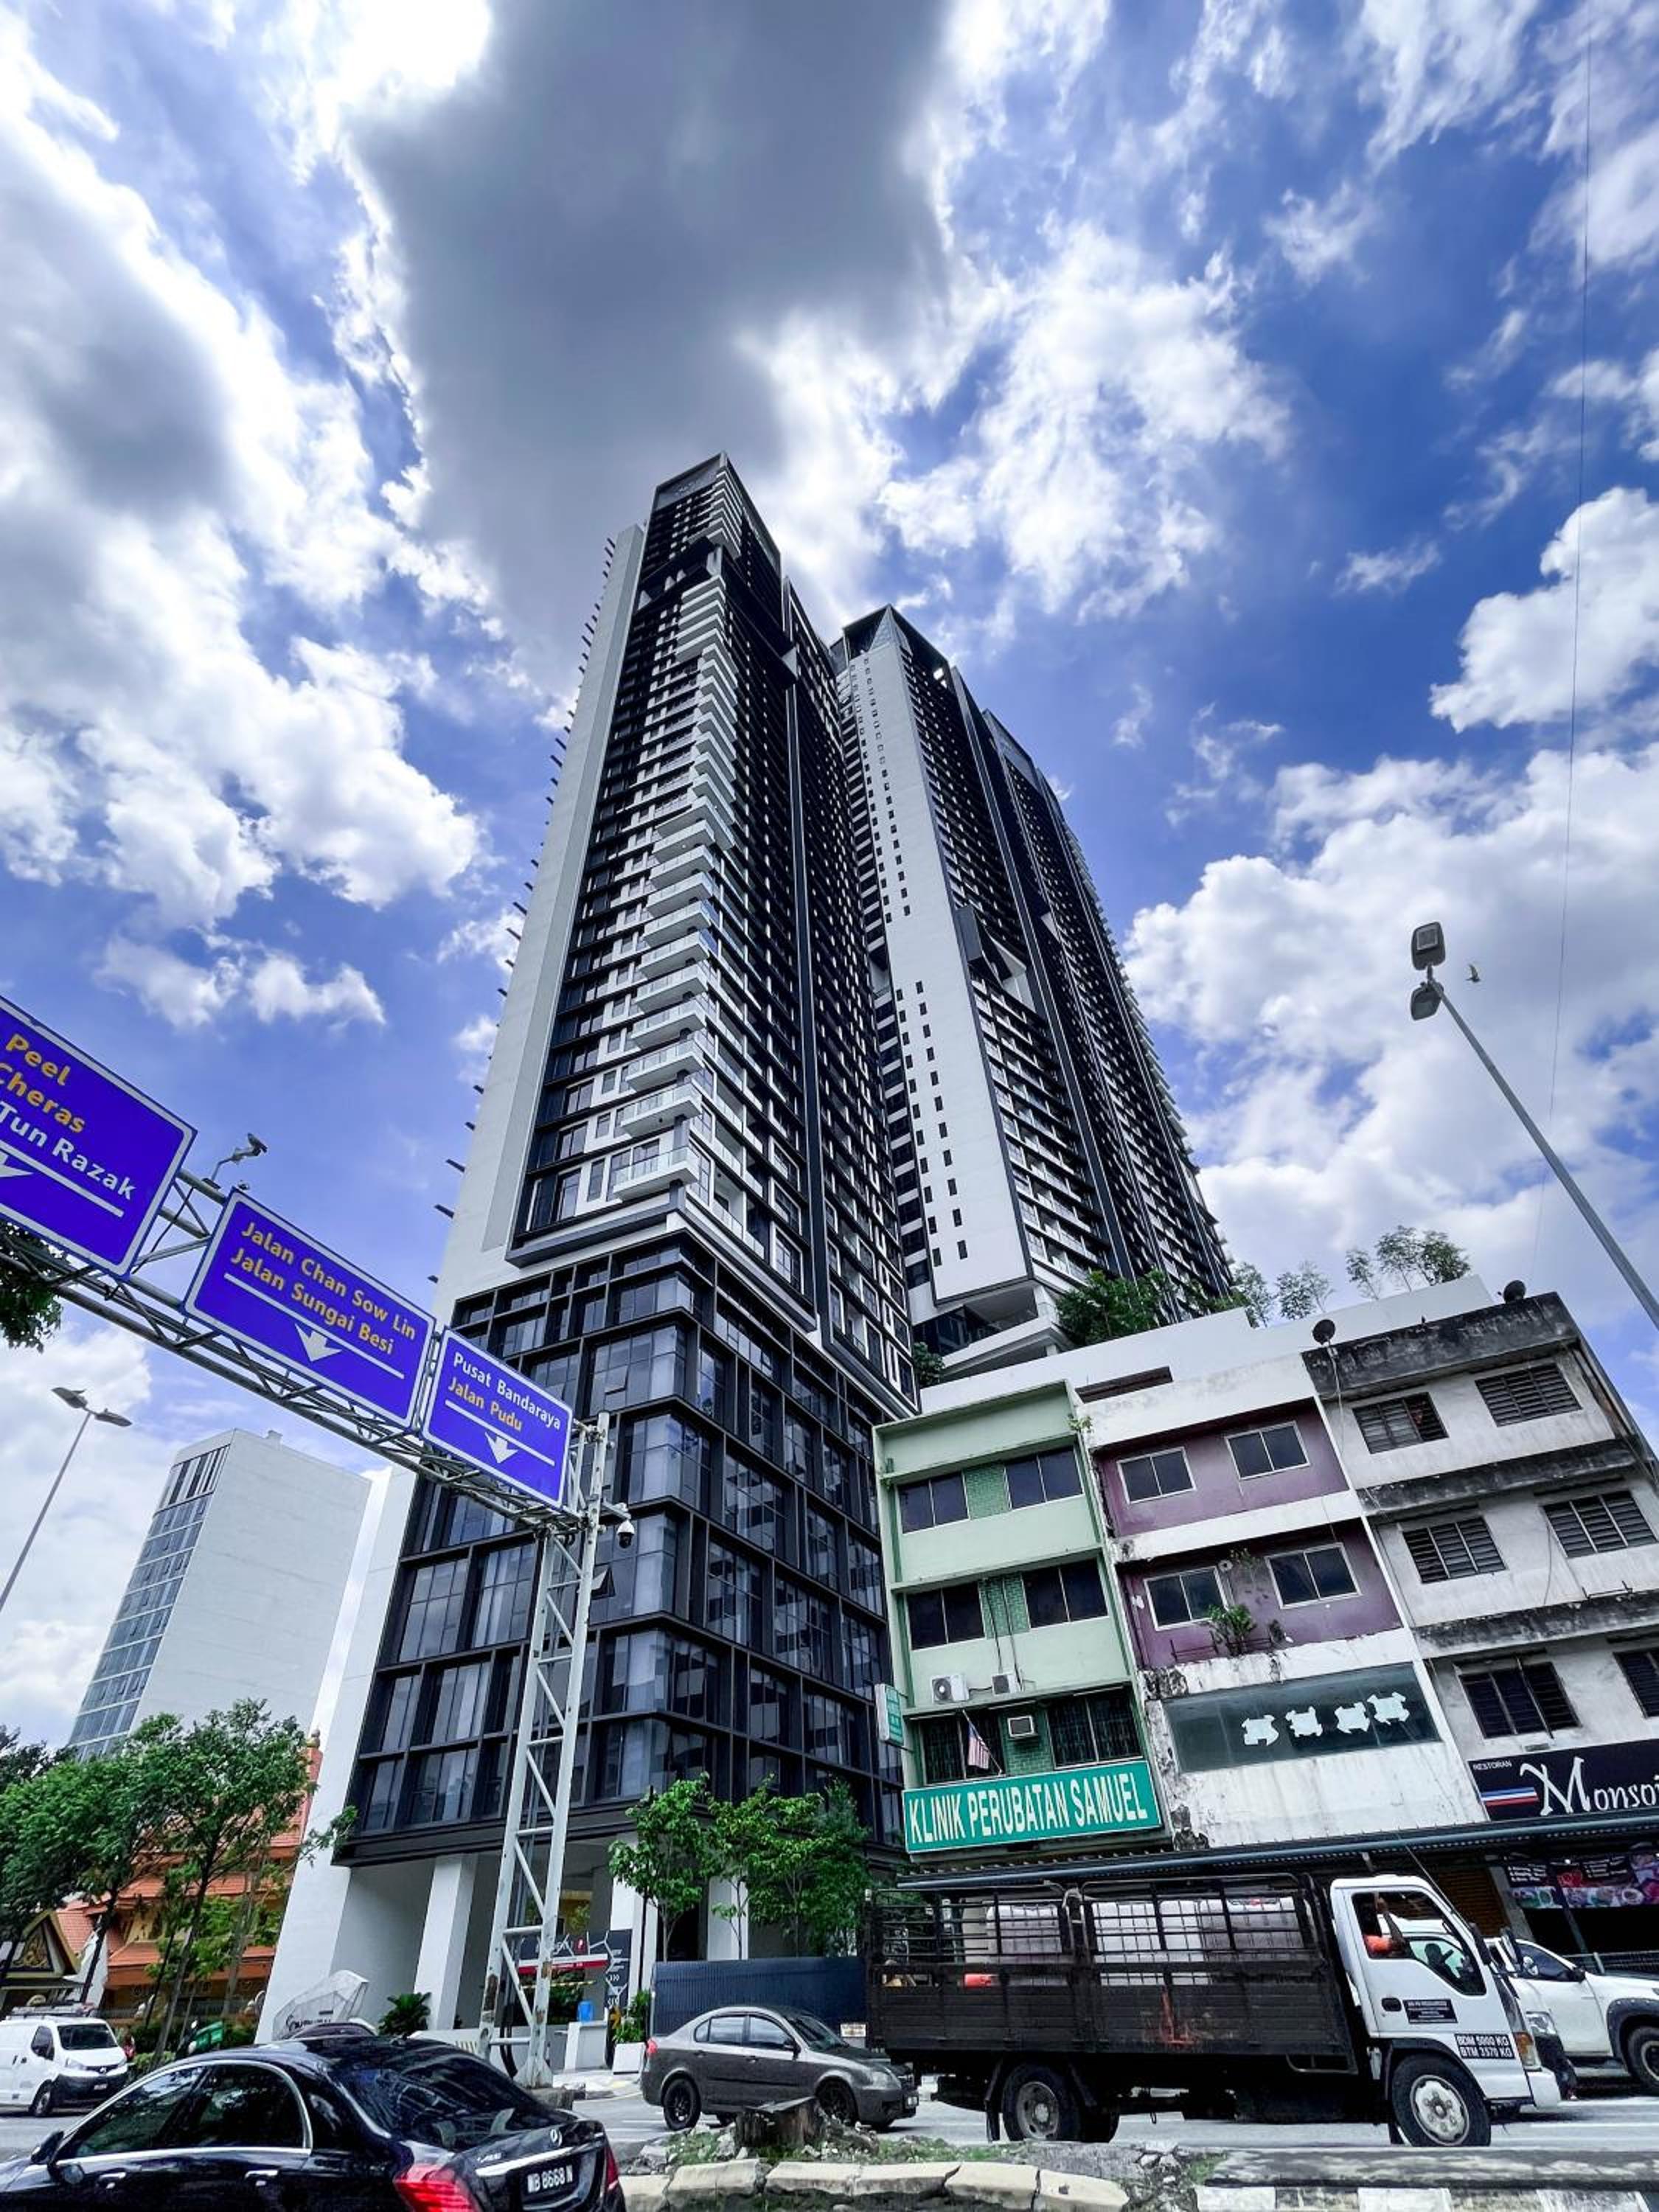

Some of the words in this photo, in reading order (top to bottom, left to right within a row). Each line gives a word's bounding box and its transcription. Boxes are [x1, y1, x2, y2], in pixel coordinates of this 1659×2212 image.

[6, 1034, 71, 1085] Peel
[0, 1101, 48, 1147] Tun
[52, 1138, 136, 1200] Razak
[231, 1248, 285, 1290] Jalan
[291, 1283, 355, 1332] Sungai
[358, 1323, 394, 1354] Besi
[242, 1222, 294, 1265] Jalan
[301, 1258, 347, 1297] Chan
[352, 1290, 388, 1321] Sow
[392, 1315, 416, 1340] Lin
[448, 1377, 484, 1409] Jalan
[490, 1401, 523, 1432] Pudu
[453, 1352, 492, 1388] Pusat
[497, 1379, 560, 1430] Bandaraya
[908, 1792, 967, 1843] KLINIK
[967, 1781, 1071, 1837] PERUBATAN
[1070, 1772, 1149, 1827] SAMUEL
